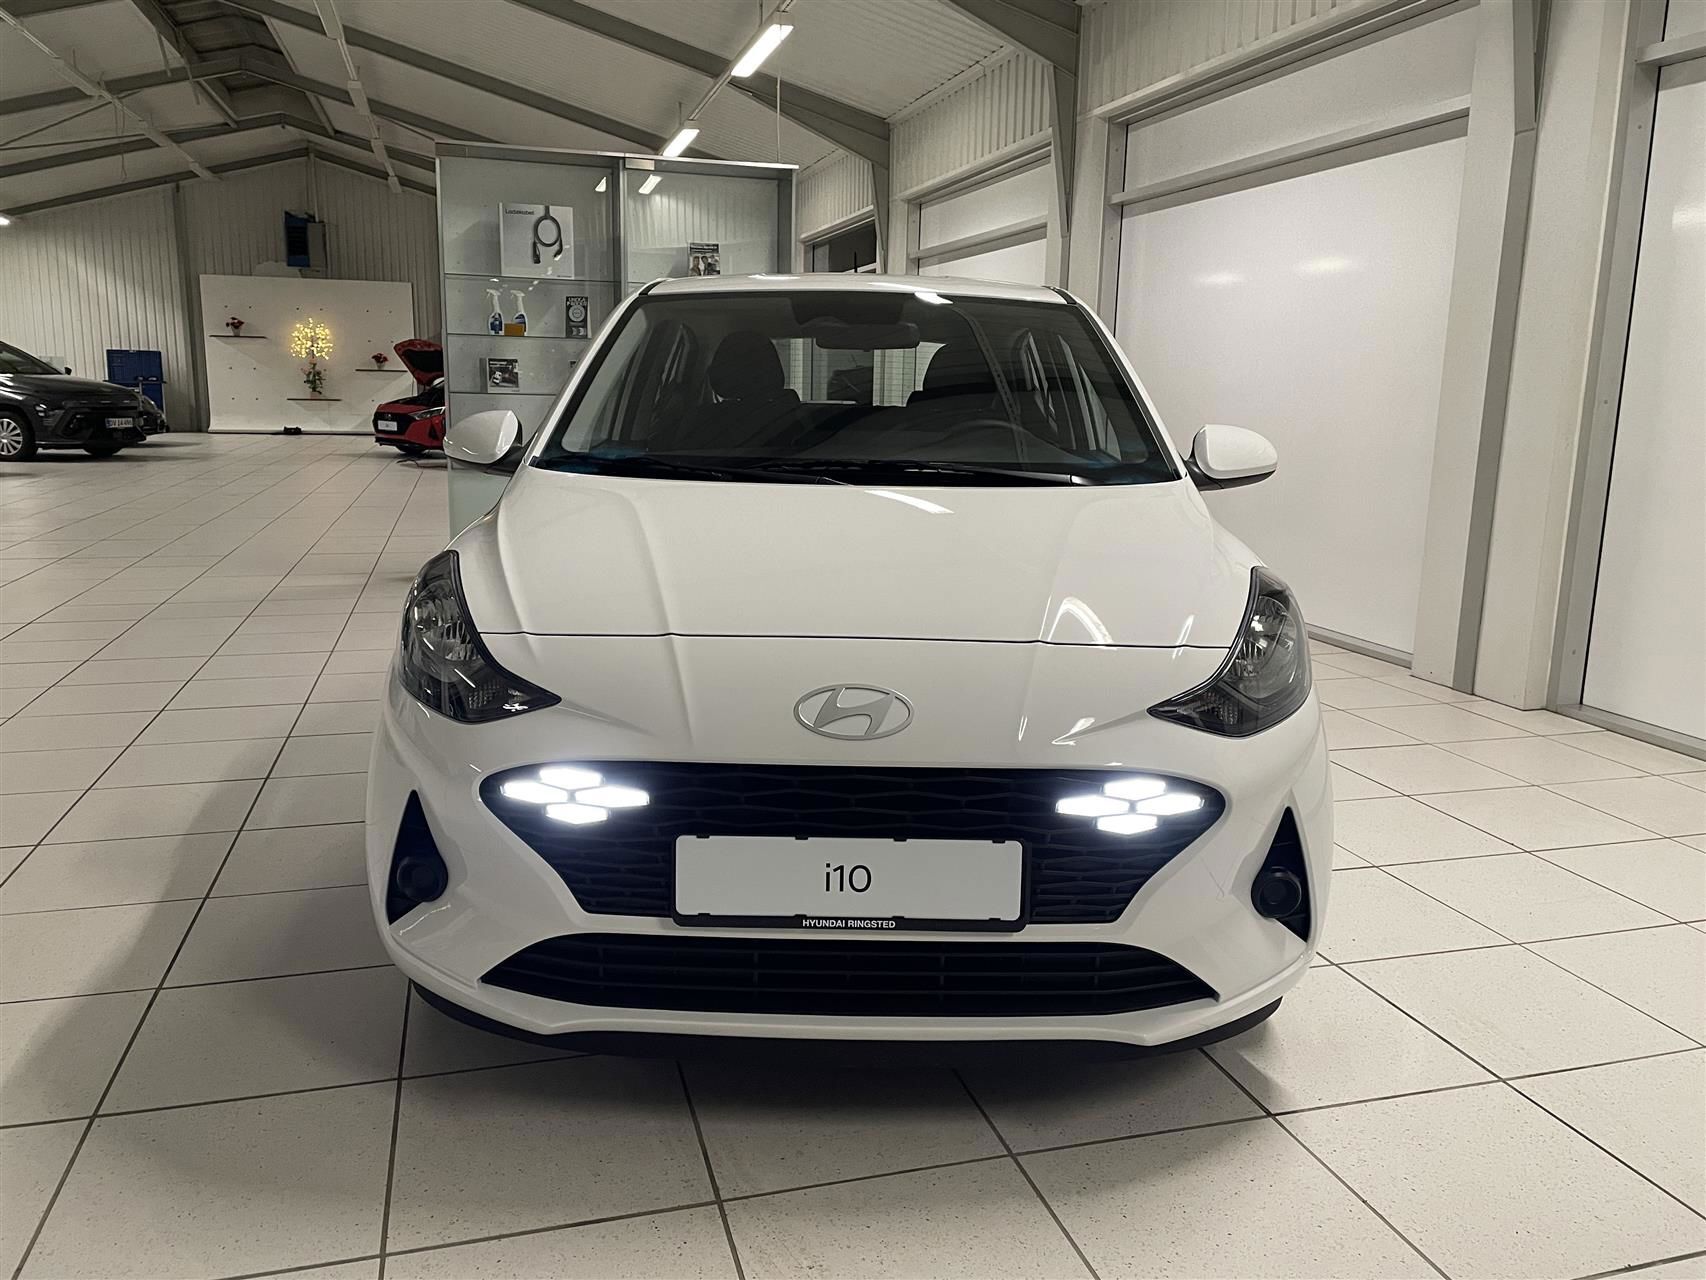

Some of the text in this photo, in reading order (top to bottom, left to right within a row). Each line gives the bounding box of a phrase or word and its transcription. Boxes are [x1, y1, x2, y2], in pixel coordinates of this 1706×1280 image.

[826, 863, 872, 893] i10
[802, 919, 896, 929] HYUNDAI RINGSTED
